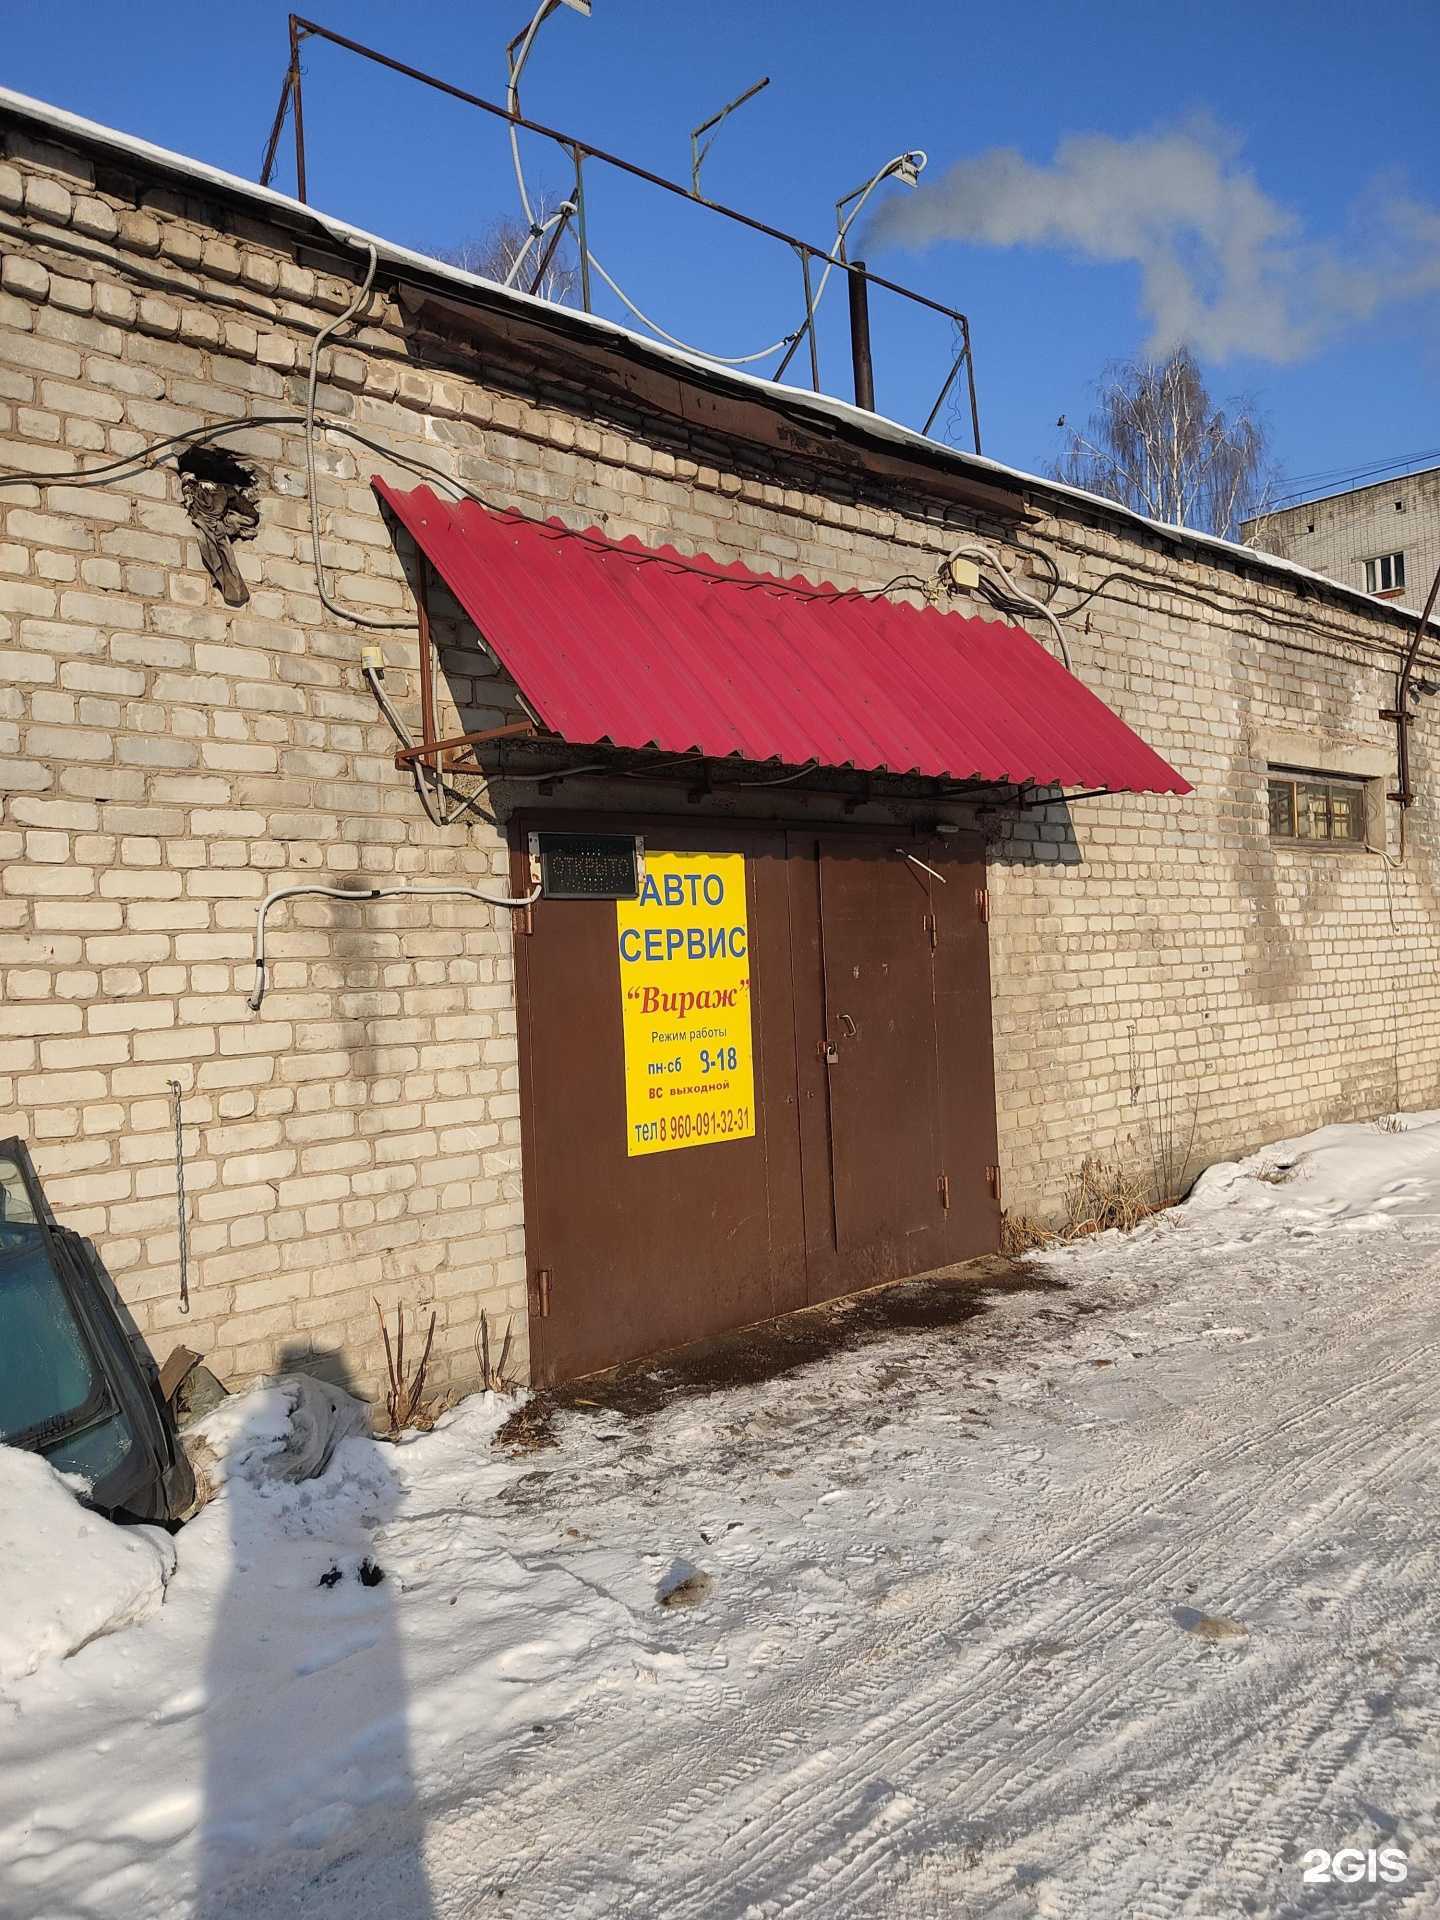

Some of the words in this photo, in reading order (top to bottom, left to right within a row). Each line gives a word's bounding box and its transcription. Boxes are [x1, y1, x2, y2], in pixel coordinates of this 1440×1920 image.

[639, 873, 724, 907] АВТО
[619, 926, 747, 962] СЕРВИС
[627, 979, 751, 1019] “Вираж”
[651, 1031, 687, 1044] Режим
[689, 1027, 727, 1042] работы
[648, 1057, 682, 1075] пн-сб
[699, 1047, 737, 1074] 9-18
[669, 1079, 730, 1096] выходной
[670, 1106, 749, 1141] 960-091-32-31
